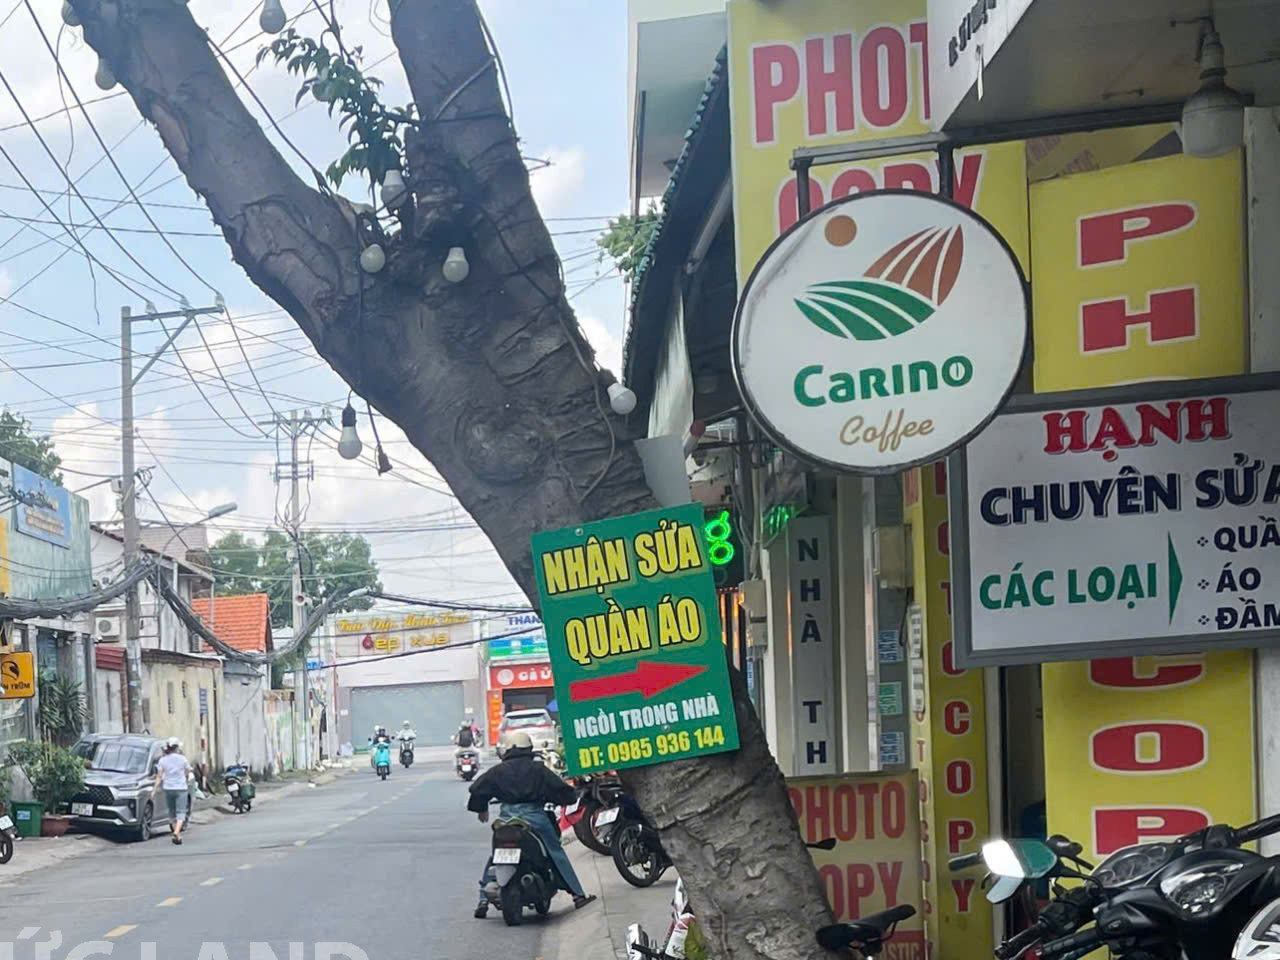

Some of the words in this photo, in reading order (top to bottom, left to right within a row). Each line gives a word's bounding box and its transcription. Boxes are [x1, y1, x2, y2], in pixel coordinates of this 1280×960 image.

[839, 408, 935, 453] Coffee
[1042, 397, 1232, 462] HẠNH
[980, 465, 1182, 526] CHUYÊN
[542, 535, 629, 594] NHẬN
[634, 518, 702, 577] SỬA
[1216, 562, 1261, 593] ÁO
[979, 563, 1055, 610] CÁC
[1068, 562, 1157, 609] LOẠI
[565, 597, 651, 665] QUẦN
[658, 594, 700, 646] ÁO
[574, 708, 616, 739] NGỒI
[620, 701, 679, 732] TRONG
[683, 692, 719, 720] NHÀ
[608, 736, 652, 763] 0985
[657, 730, 690, 756] 936
[694, 725, 725, 749] 144
[820, 861, 904, 922] OPY
